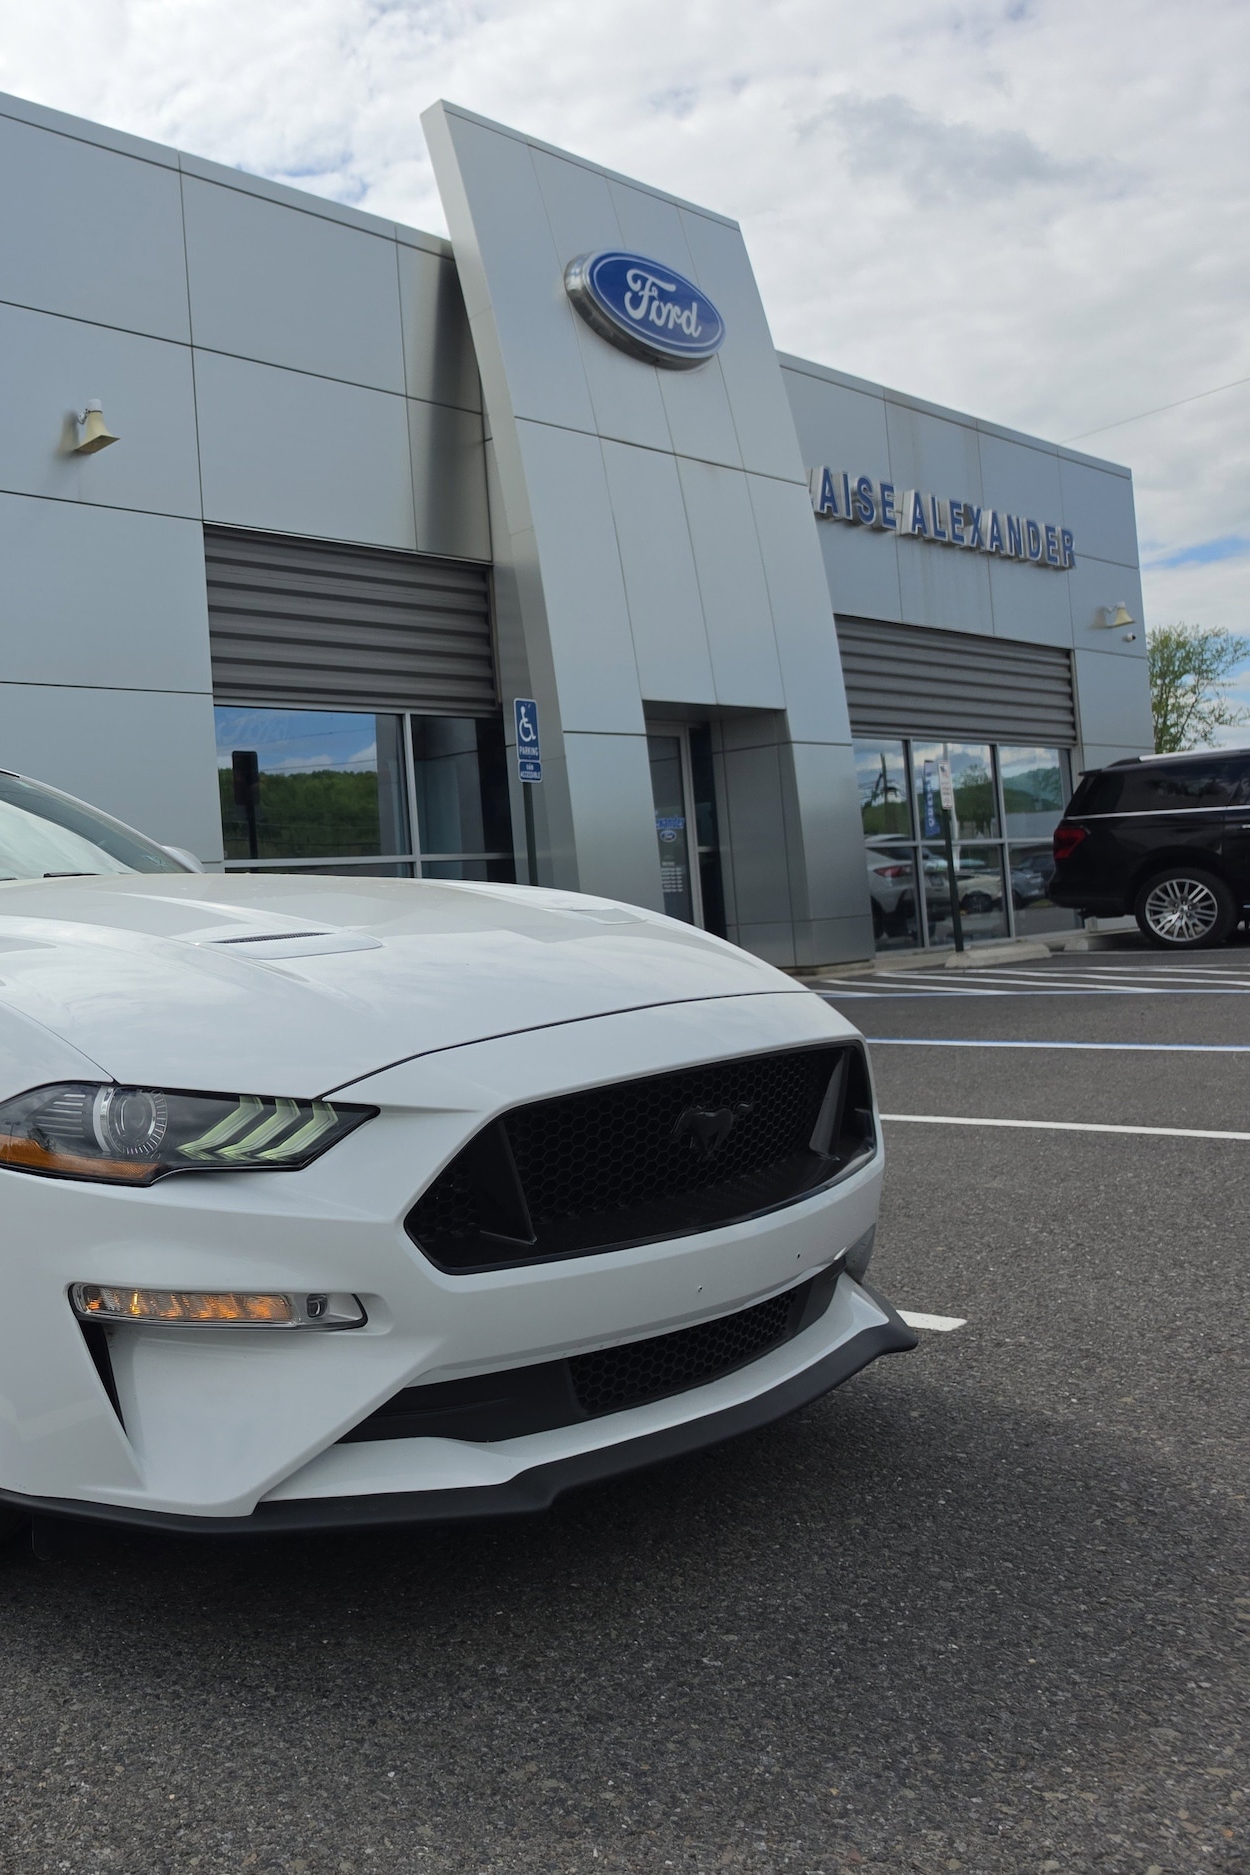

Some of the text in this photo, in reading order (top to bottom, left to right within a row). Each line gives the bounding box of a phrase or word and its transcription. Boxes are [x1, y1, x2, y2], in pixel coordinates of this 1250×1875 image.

[624, 268, 702, 338] Ford
[811, 466, 1076, 568] AISE ALEXANDER
